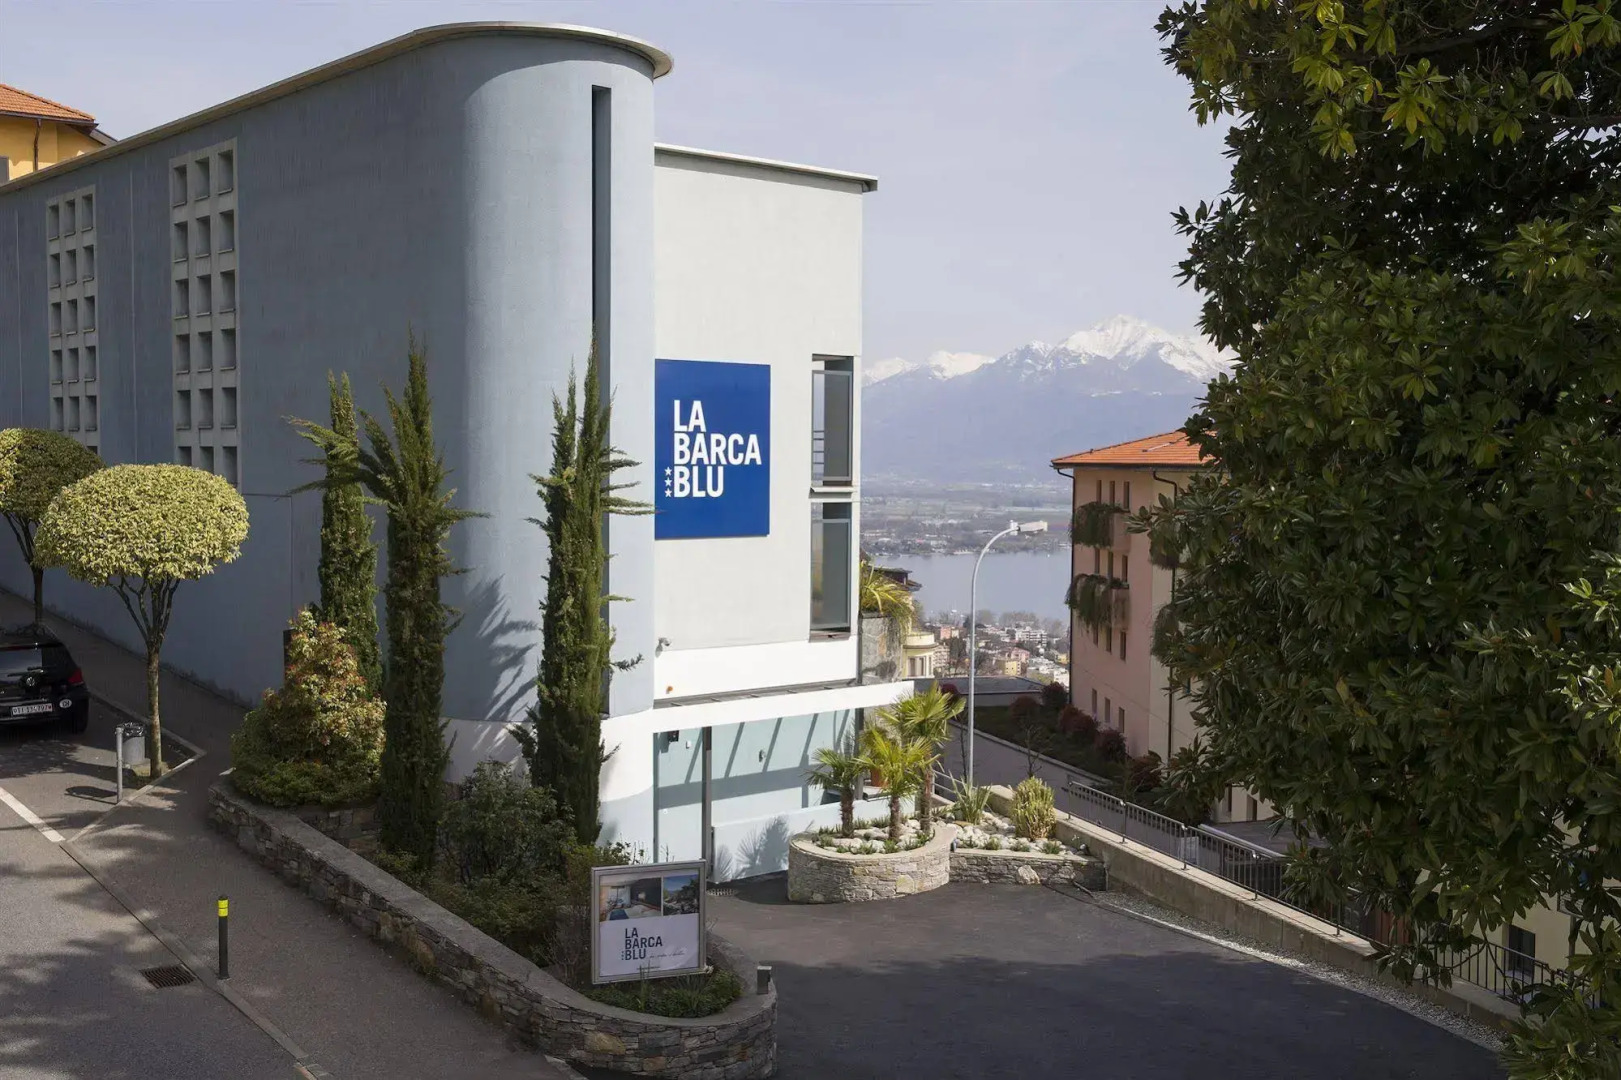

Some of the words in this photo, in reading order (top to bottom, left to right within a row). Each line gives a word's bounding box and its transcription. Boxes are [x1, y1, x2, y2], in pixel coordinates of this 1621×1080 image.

[673, 399, 707, 432] LA
[673, 432, 762, 466] BARCA
[673, 465, 724, 498] BLU
[625, 927, 639, 938] LA
[625, 936, 663, 949] BARCA
[625, 948, 646, 961] BLU
